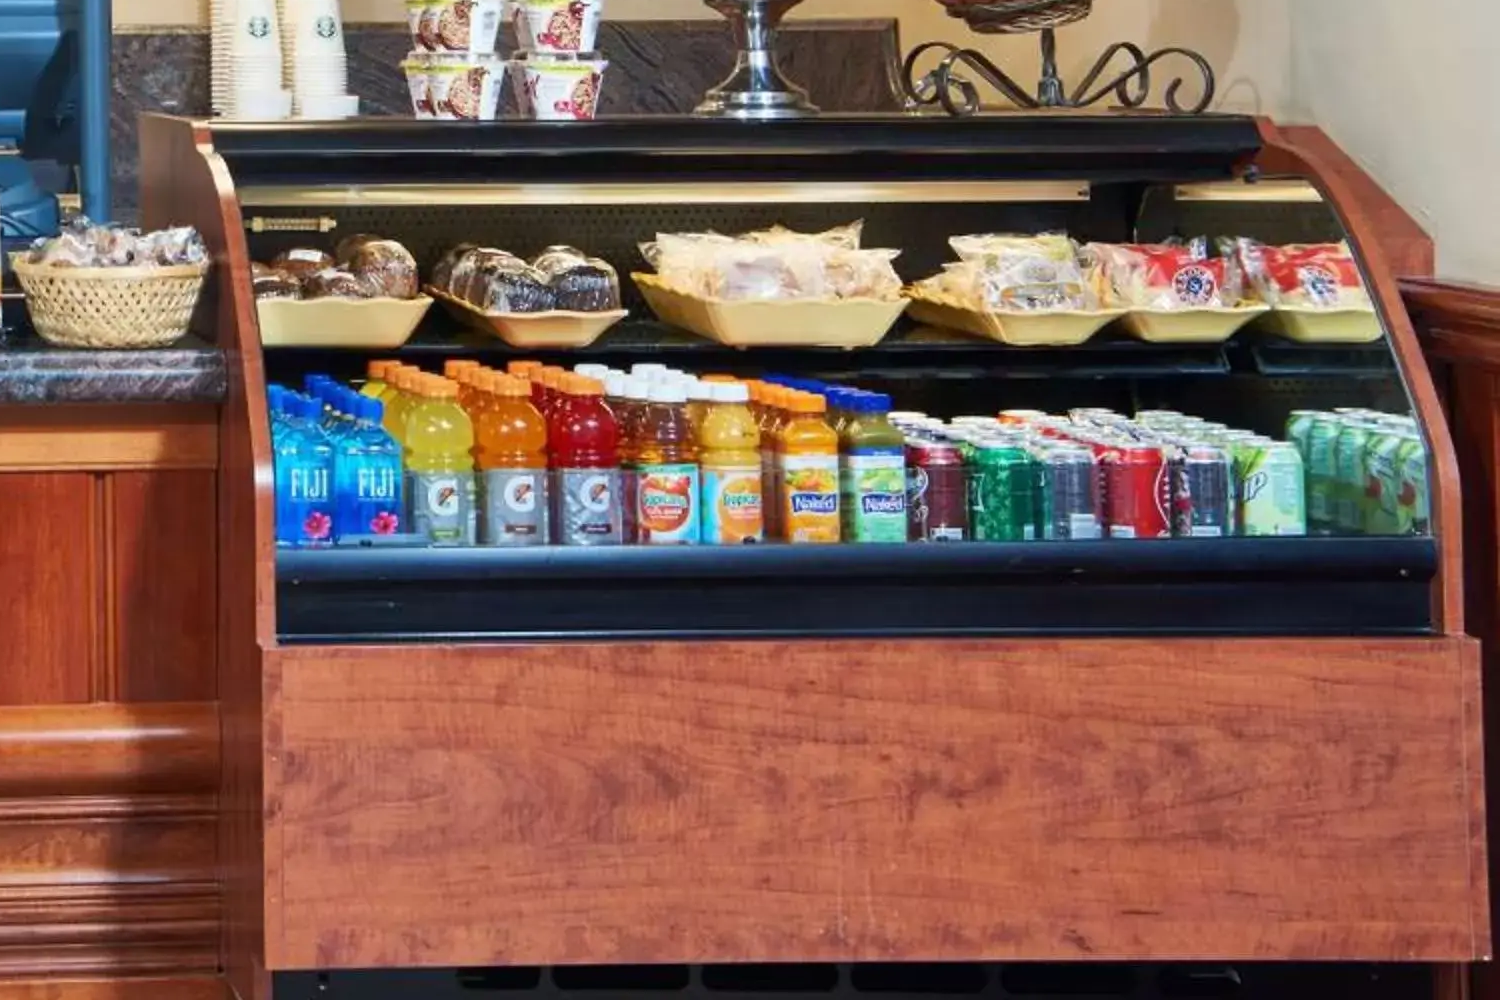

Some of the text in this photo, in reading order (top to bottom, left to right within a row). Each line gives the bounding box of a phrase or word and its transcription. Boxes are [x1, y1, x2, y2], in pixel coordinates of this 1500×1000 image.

[291, 468, 328, 498] FIJI
[358, 467, 395, 498] FIJI
[795, 495, 835, 511] Naked
[865, 496, 904, 511] Naked
